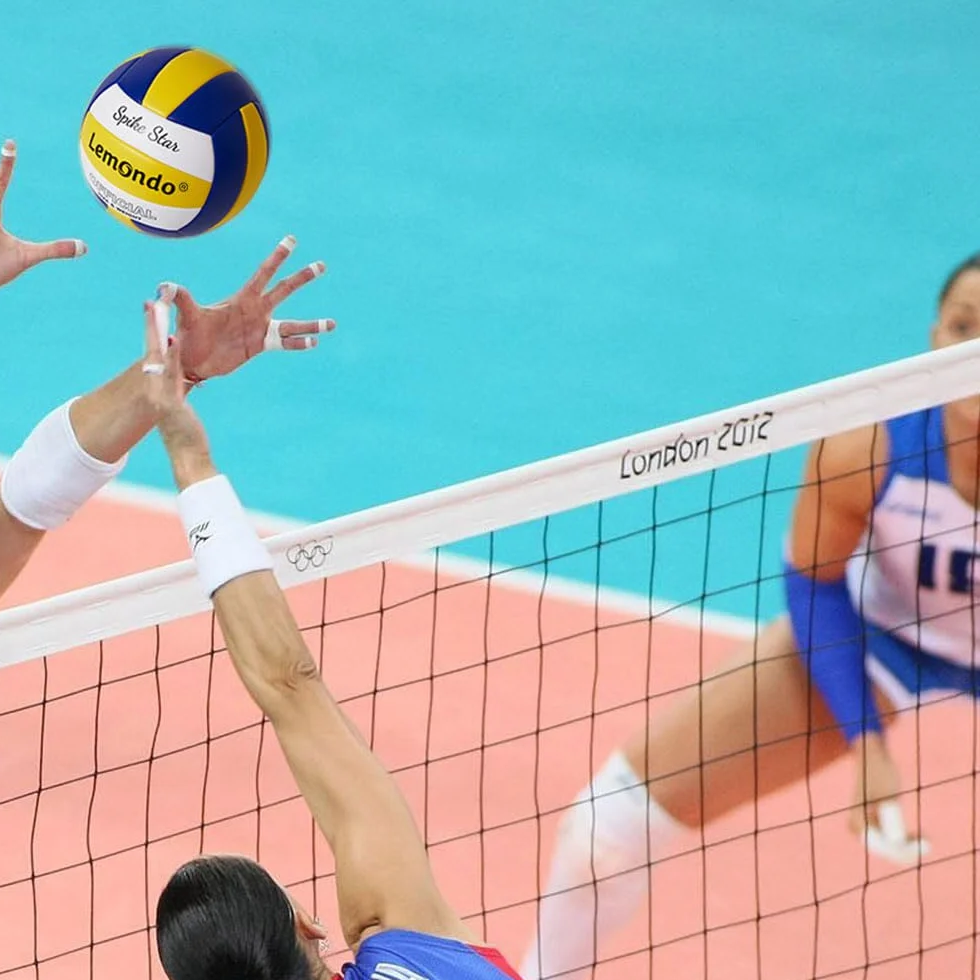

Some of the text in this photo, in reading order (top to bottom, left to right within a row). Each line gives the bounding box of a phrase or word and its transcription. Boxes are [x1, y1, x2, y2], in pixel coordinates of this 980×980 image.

[112, 105, 180, 153] Spike Star
[620, 411, 774, 480] London 2012
